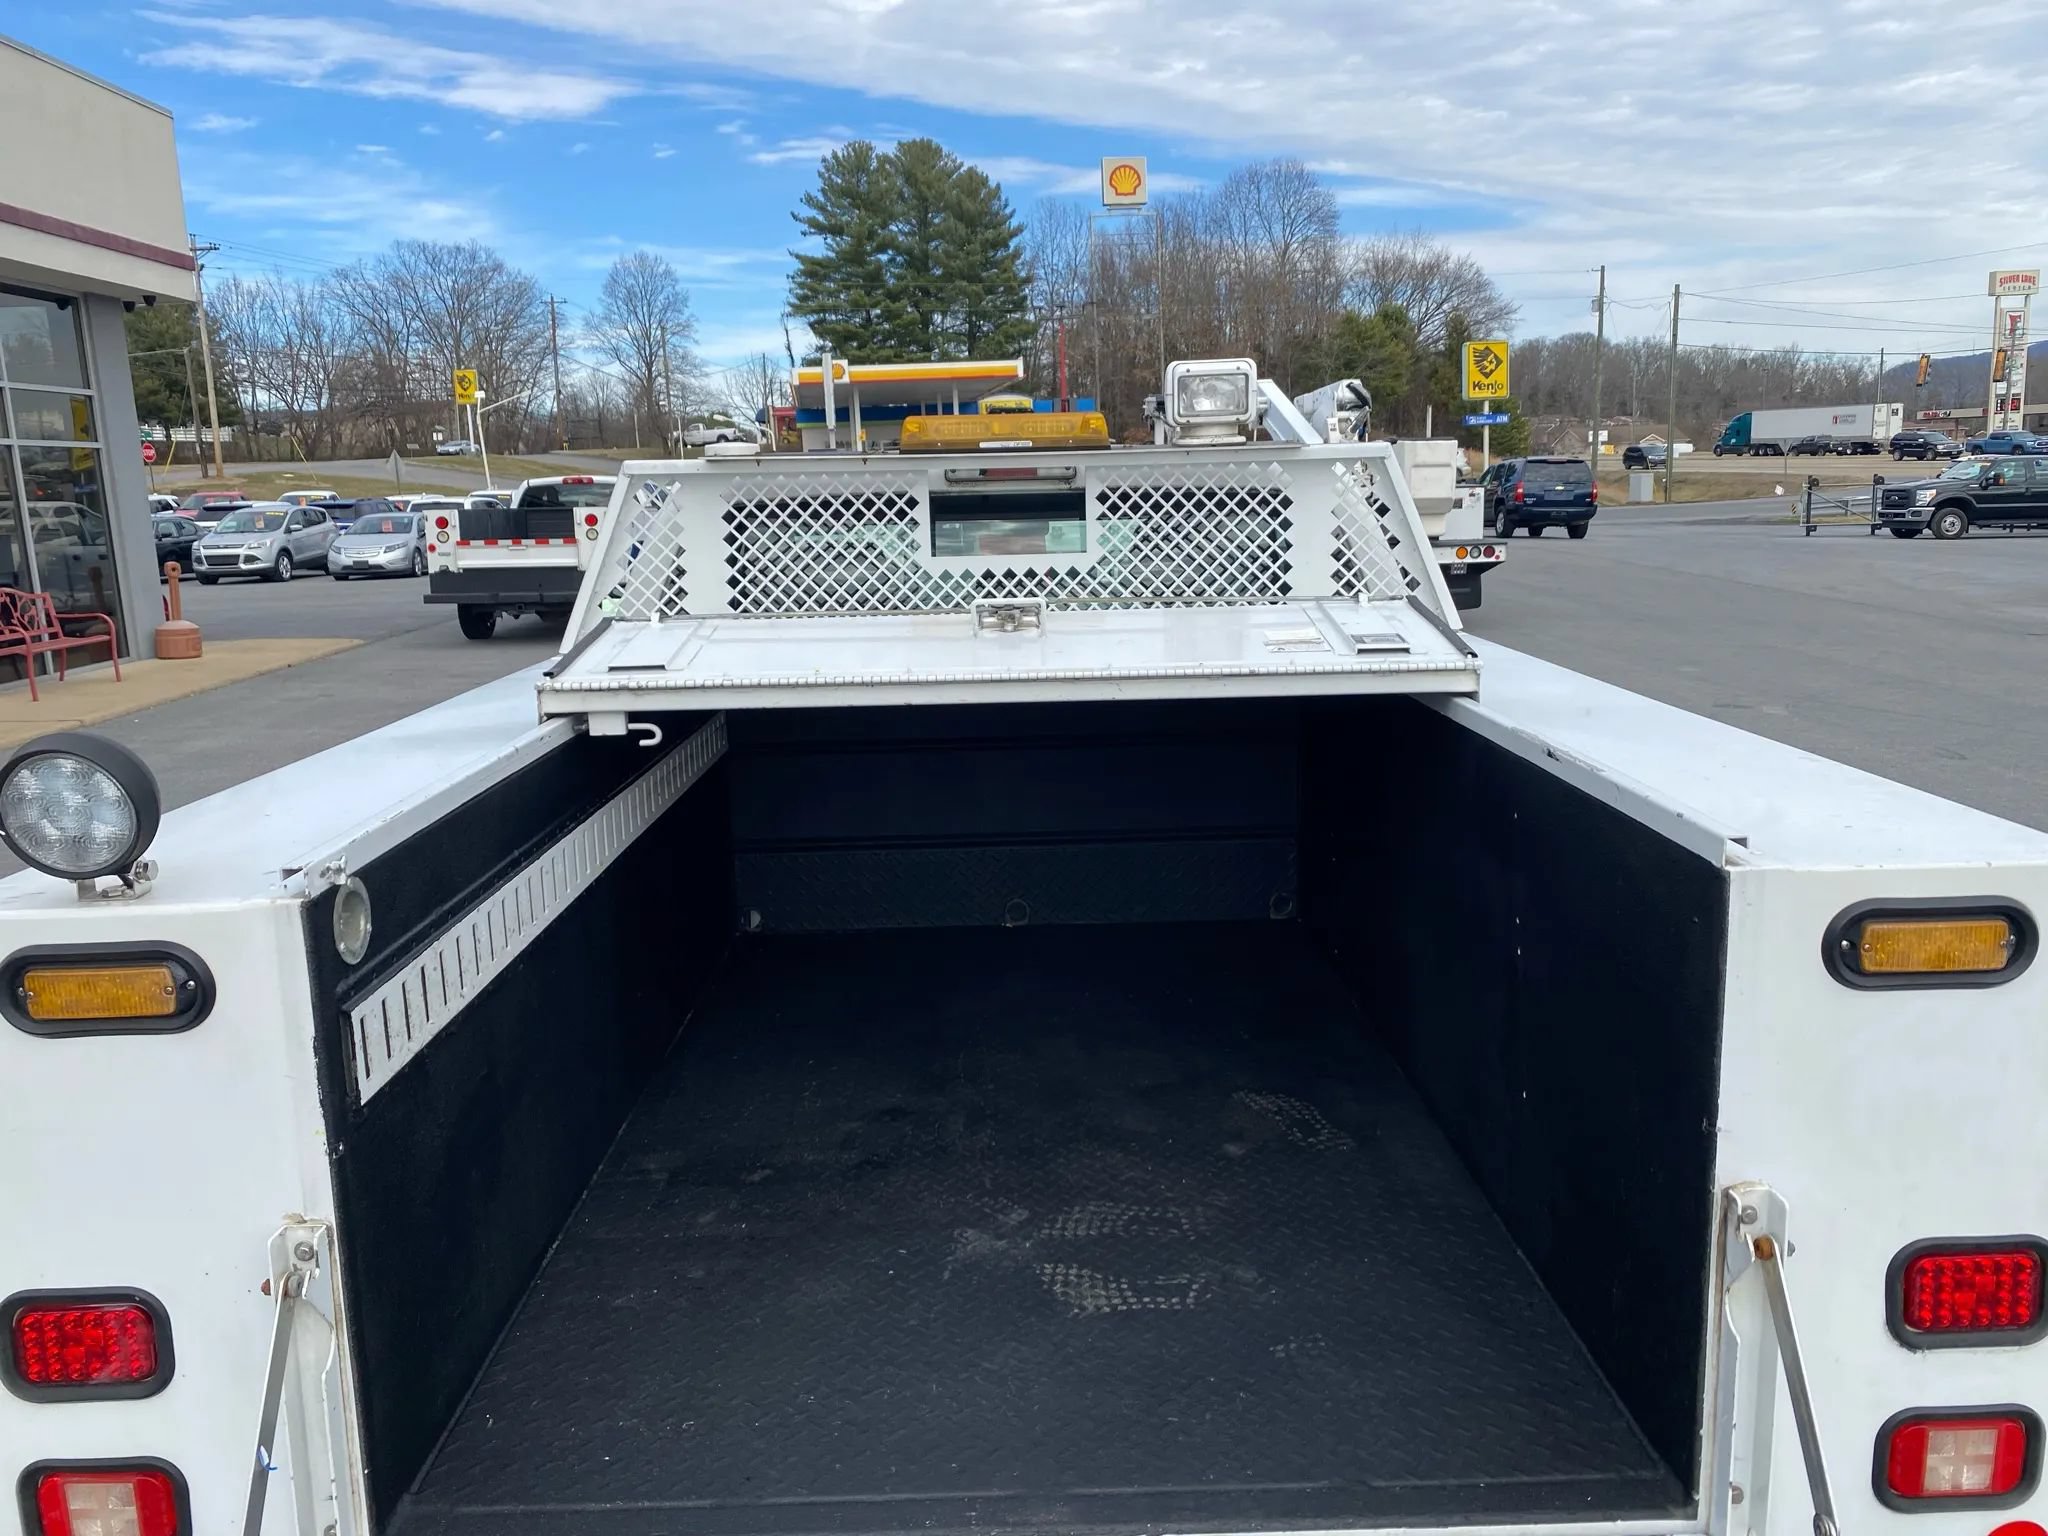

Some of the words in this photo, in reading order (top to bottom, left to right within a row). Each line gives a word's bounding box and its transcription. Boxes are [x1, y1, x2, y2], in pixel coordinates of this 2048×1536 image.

[1999, 274, 2020, 287] SILVER
[2021, 273, 2036, 286] LAKE
[1472, 380, 1504, 395] Kenjo
[1496, 415, 1508, 423] ATM
